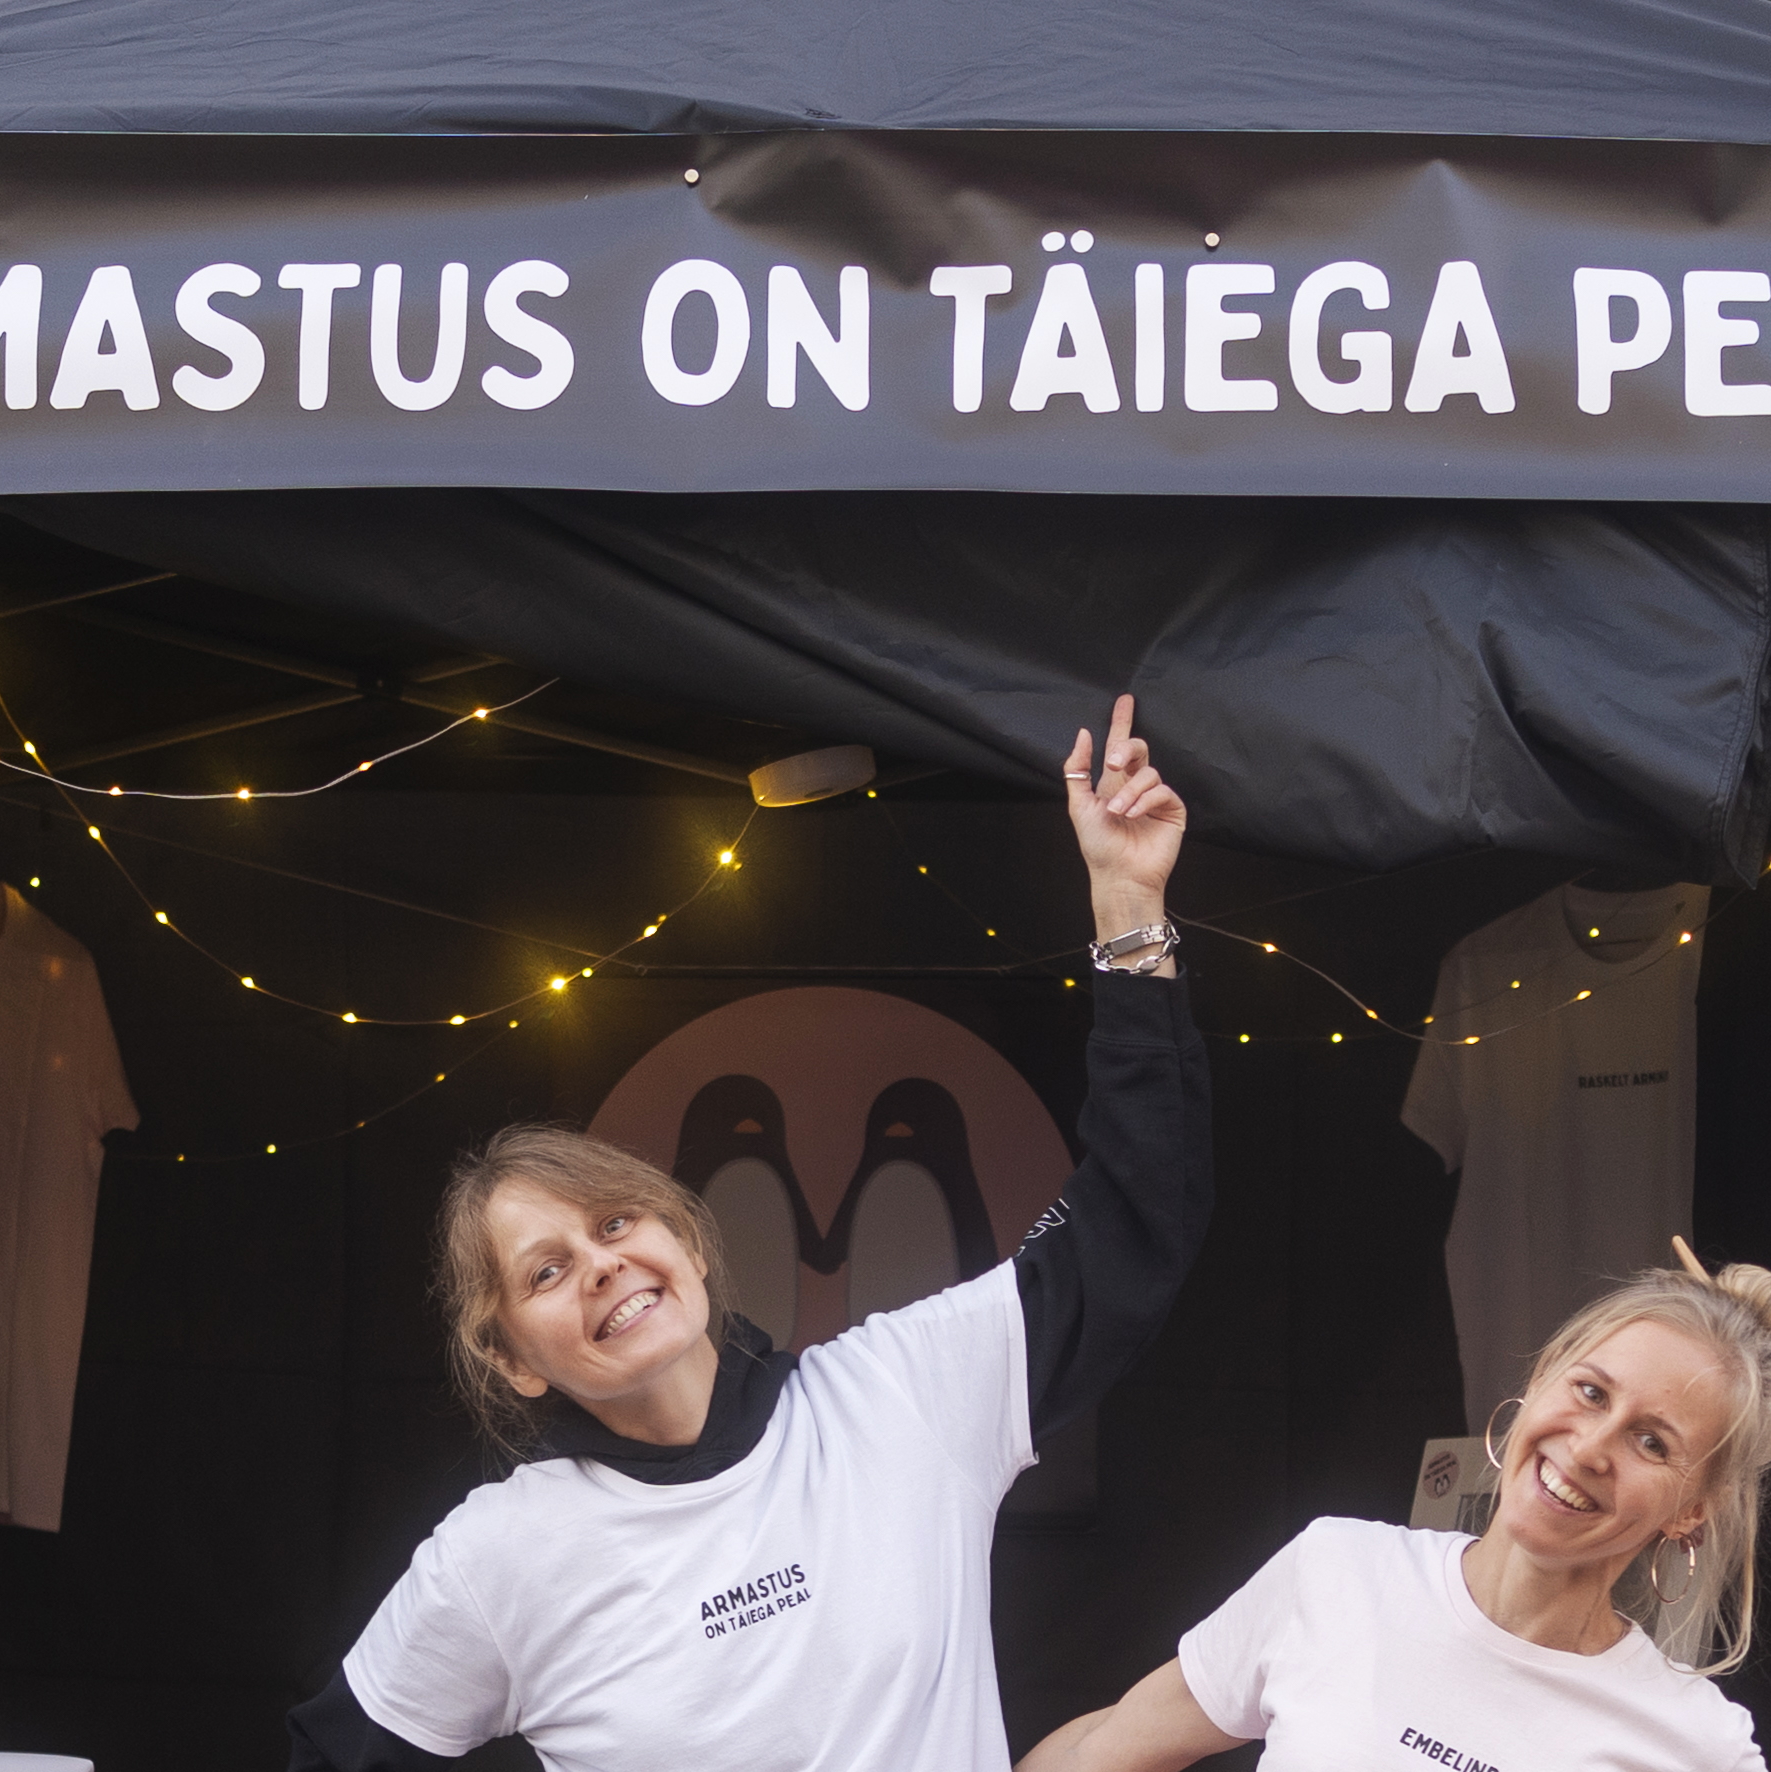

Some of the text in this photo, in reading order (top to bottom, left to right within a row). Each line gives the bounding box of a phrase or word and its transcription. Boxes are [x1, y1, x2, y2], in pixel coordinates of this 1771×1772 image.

[640, 258, 871, 409] ON
[929, 228, 1517, 414] TÄIEGA
[1578, 1073, 1629, 1089] RASKELT
[701, 1563, 806, 1622] ARMASTUS
[705, 1587, 812, 1639] ON TÄIEGA PEAL
